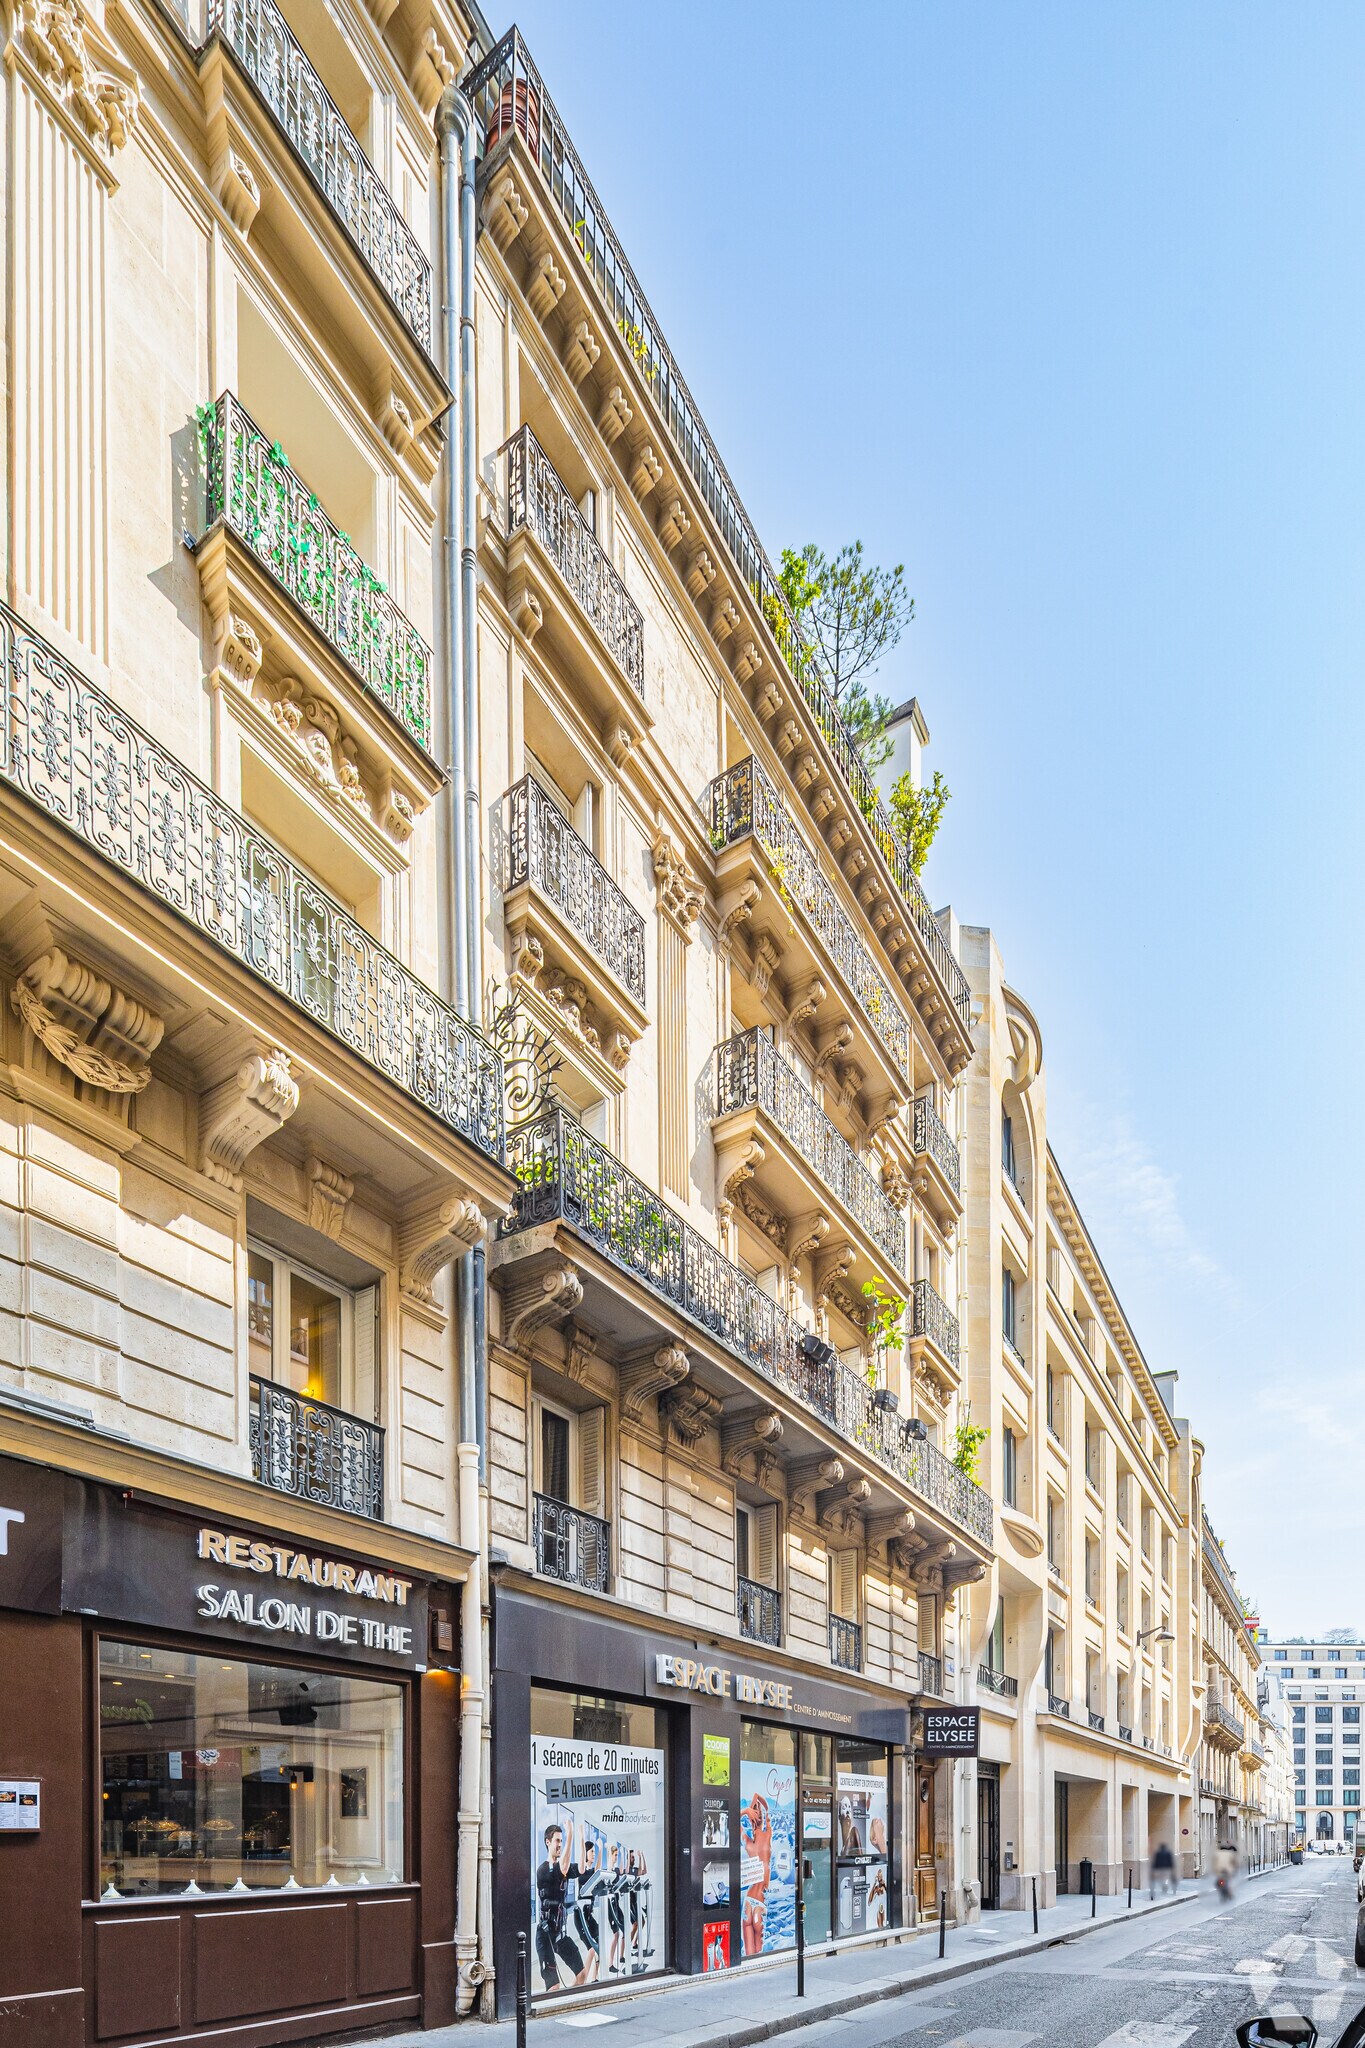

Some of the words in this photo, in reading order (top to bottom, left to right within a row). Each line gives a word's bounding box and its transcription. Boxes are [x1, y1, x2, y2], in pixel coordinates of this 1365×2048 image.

[197, 1528, 412, 1605] RESTAURANT
[197, 1584, 311, 1635] SALON
[314, 1610, 358, 1645] DE
[358, 1618, 412, 1655] THE
[655, 1654, 731, 1698] ESPACE
[735, 1674, 793, 1711] ELYSEE
[793, 1703, 812, 1717] CENTRE
[812, 1707, 852, 1724] D'AMINCISSEMENT
[927, 1715, 976, 1728] ESPACE
[927, 1730, 975, 1742] ELYSEE
[531, 1741, 537, 1765] 1
[543, 1743, 583, 1769] séance
[587, 1748, 600, 1770] de
[604, 1749, 617, 1772] 20
[621, 1752, 659, 1775] minutes
[561, 1780, 568, 1799] 4
[571, 1780, 602, 1799] heures
[604, 1784, 615, 1796] en
[617, 1776, 637, 1794] salle
[602, 1811, 624, 1822] miha
[624, 1811, 651, 1825] bodytec
